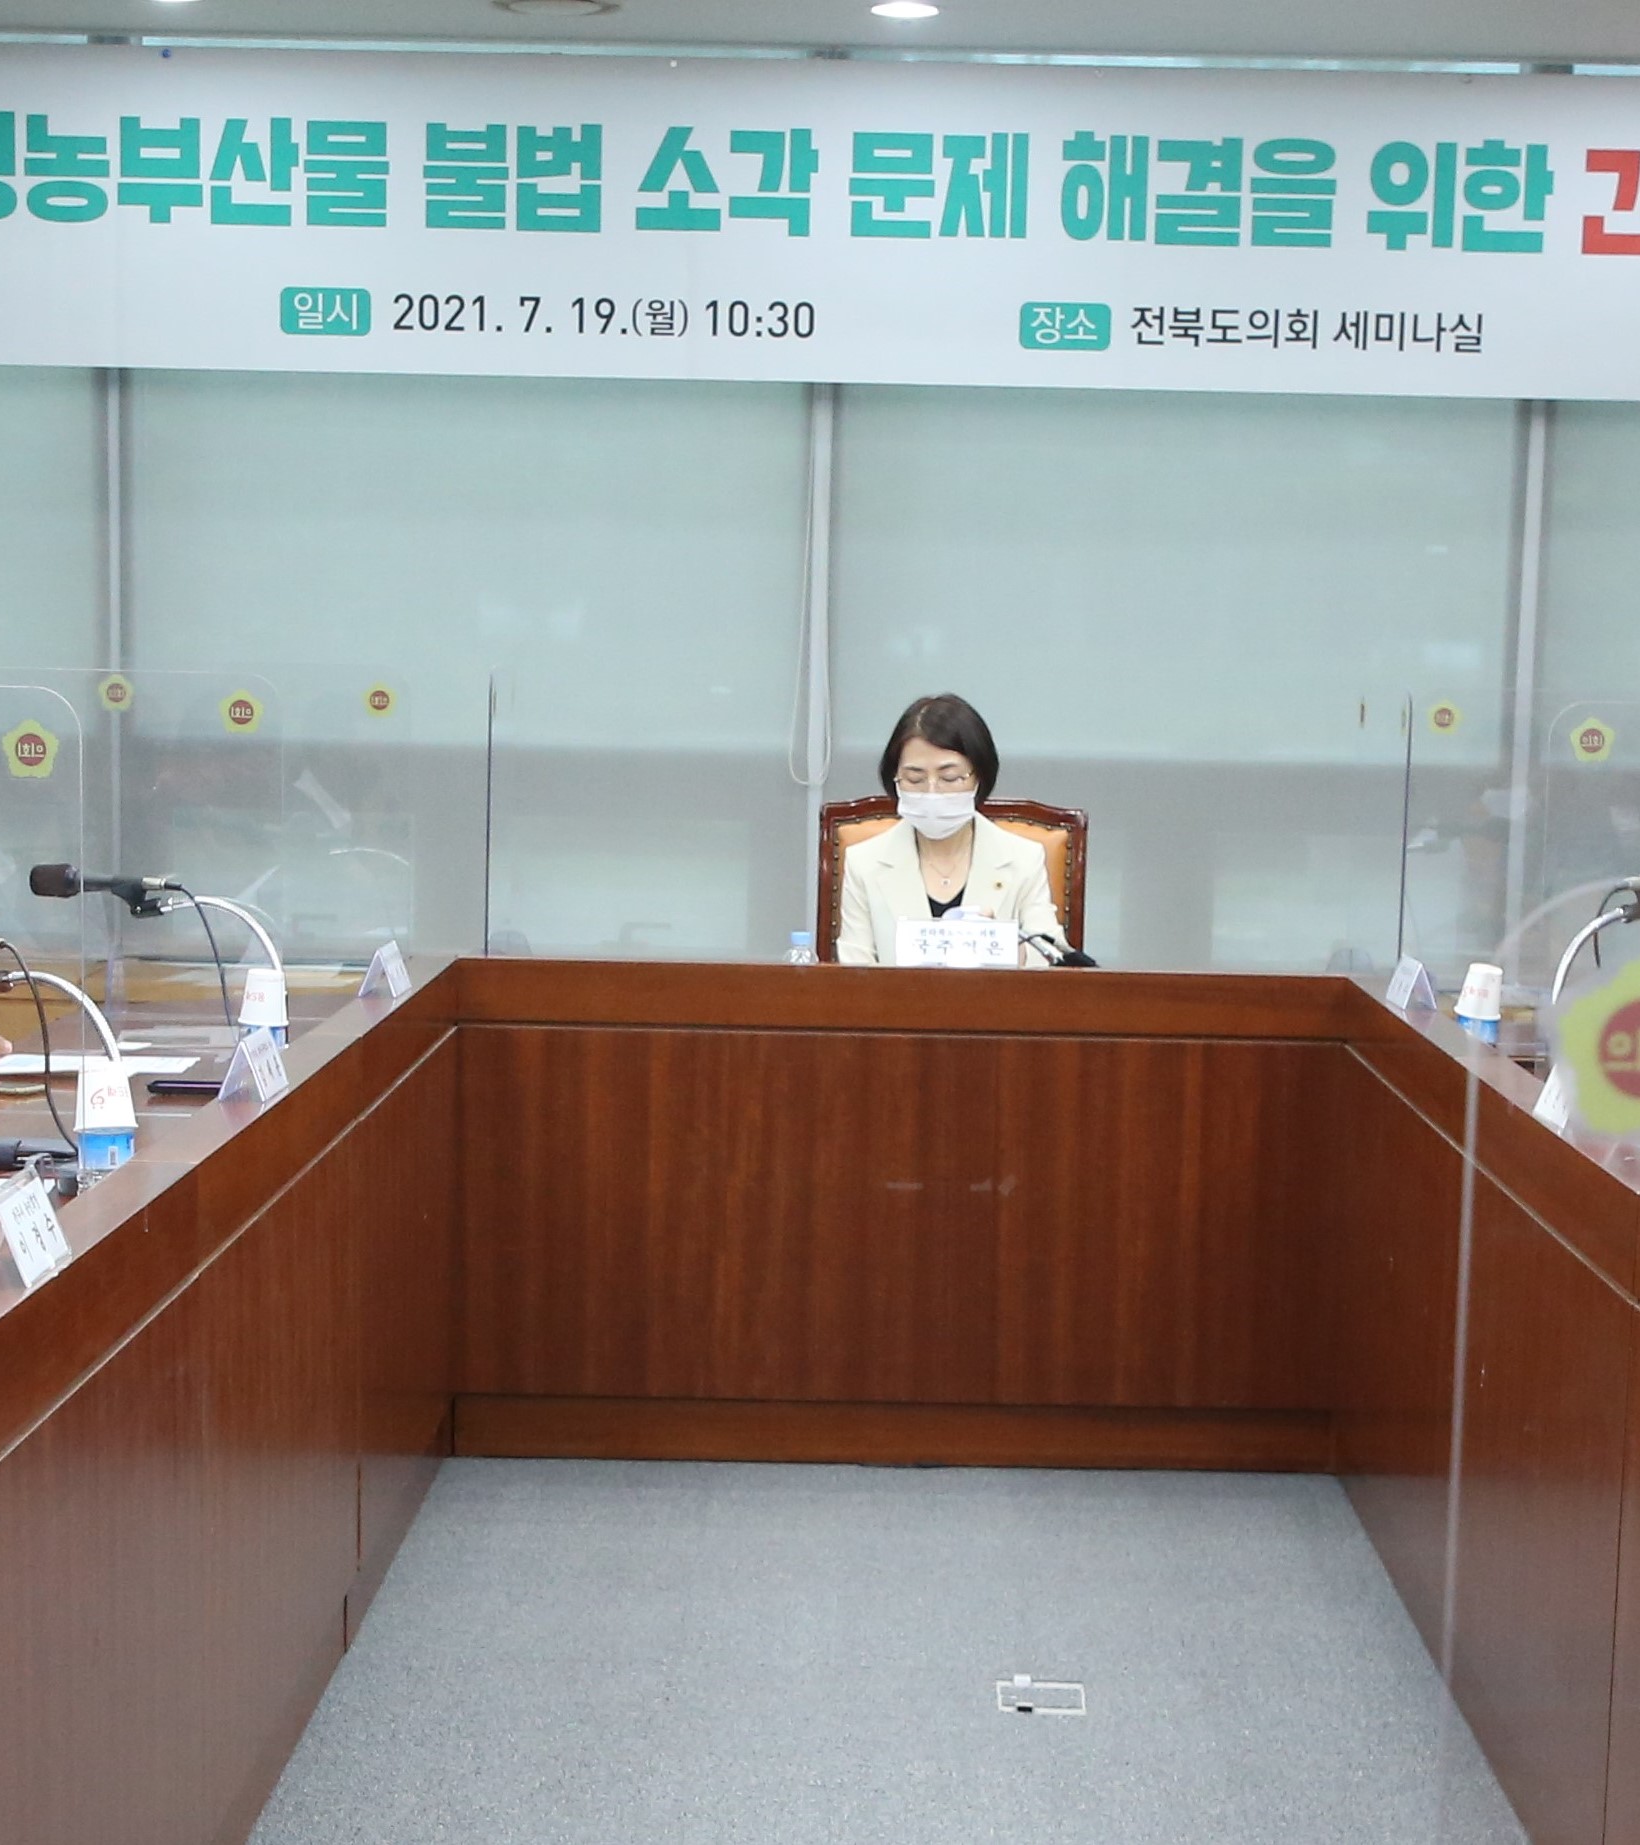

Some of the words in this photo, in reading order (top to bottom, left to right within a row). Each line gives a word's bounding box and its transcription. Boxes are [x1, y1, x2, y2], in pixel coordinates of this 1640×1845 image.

[423, 122, 605, 234] 불법
[635, 126, 822, 238] 소각
[848, 131, 1032, 241] 문제
[1060, 131, 1340, 249] 해결을
[1367, 139, 1556, 254] 위한
[293, 293, 360, 331] 일시
[393, 294, 505, 334] 2021.
[519, 297, 553, 335] 7.
[706, 301, 817, 340] 10:30
[1030, 307, 1100, 345] 장소
[1131, 307, 1320, 351] 전북도의회
[1333, 312, 1485, 355] 세미나실
